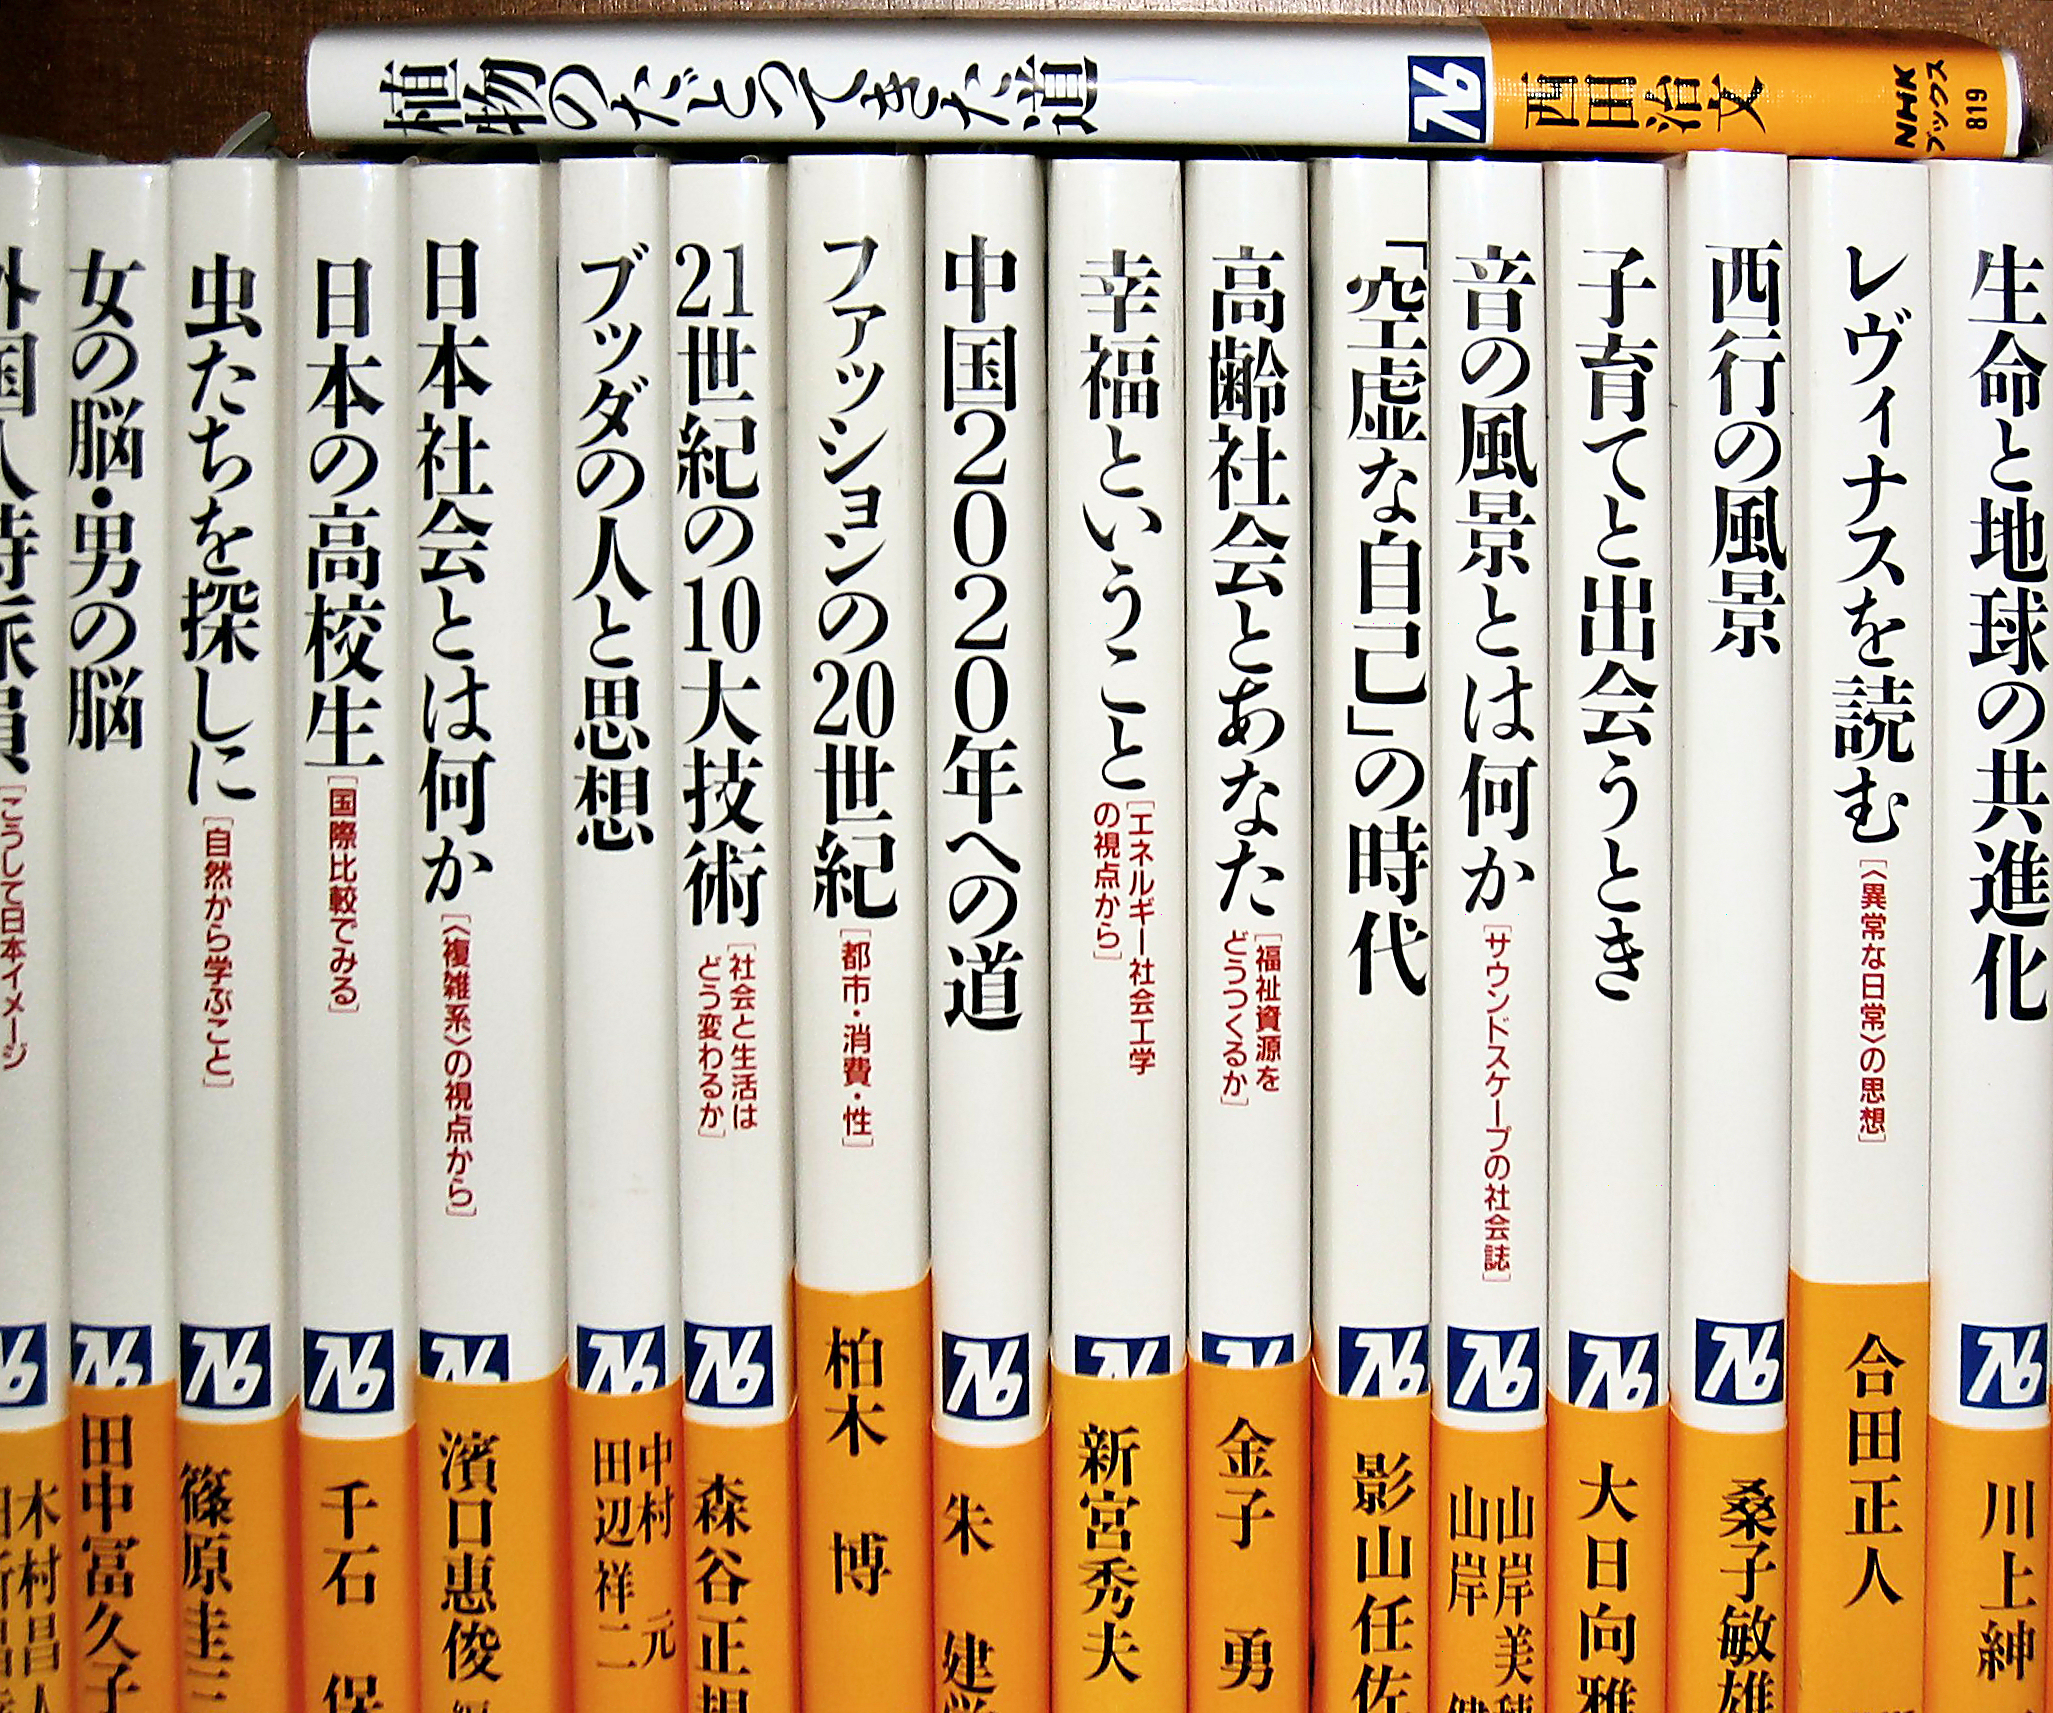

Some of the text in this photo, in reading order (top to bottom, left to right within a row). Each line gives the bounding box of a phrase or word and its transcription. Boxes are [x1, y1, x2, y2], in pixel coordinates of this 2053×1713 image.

[374, 54, 1111, 143] 植物のたどってきた道
[1521, 72, 1766, 133] 西田治文
[1893, 64, 1917, 149] NHK
[1926, 59, 1949, 152] ブックス
[1965, 88, 1988, 130] 819
[67, 248, 145, 752] 女の脳・男の脳
[180, 252, 263, 806] 虫たちを探しに
[304, 257, 386, 767] 日本の高校生
[416, 238, 496, 904] 日本社会とは何か
[572, 242, 654, 851] ブッダの人と思想
[812, 237, 898, 919] ファッションの20世紀
[1081, 250, 1162, 790] 幸福ということ
[1209, 246, 1291, 917] 高齢社会とあなた
[1452, 245, 1538, 913] 音の風景とは何か
[1705, 238, 1788, 658] 西行の風景
[1834, 245, 1916, 844] レヴィナスを読む
[675, 243, 768, 928] 21世紀の10大技術
[942, 234, 1024, 1031] 中国2020年への道
[1346, 240, 1429, 997] 「空虚な自己」の時代
[1575, 247, 1659, 1002] 子育てと出会うとき
[1968, 243, 2050, 1021] 生命と地球の共進化
[179, 1462, 233, 1700] 篠原圭三
[322, 1480, 379, 1606] 千石
[594, 1438, 635, 1667] 田辺祥二
[638, 1432, 676, 1665] 中村 元
[824, 1326, 890, 1596] 柏木 博
[945, 1493, 992, 1556] 朱
[1079, 1423, 1140, 1683] 新宮秀夫
[1216, 1416, 1275, 1550] 金子
[1352, 1452, 1416, 1713] 影山任佐
[1449, 1484, 1488, 1617] 山岸
[1719, 1477, 1777, 1713] 桑子敏雄
[1844, 1333, 1905, 1605] 合田正人
[1978, 1480, 2037, 1681] 川上紳
[1224, 1627, 1274, 1692] 勇
